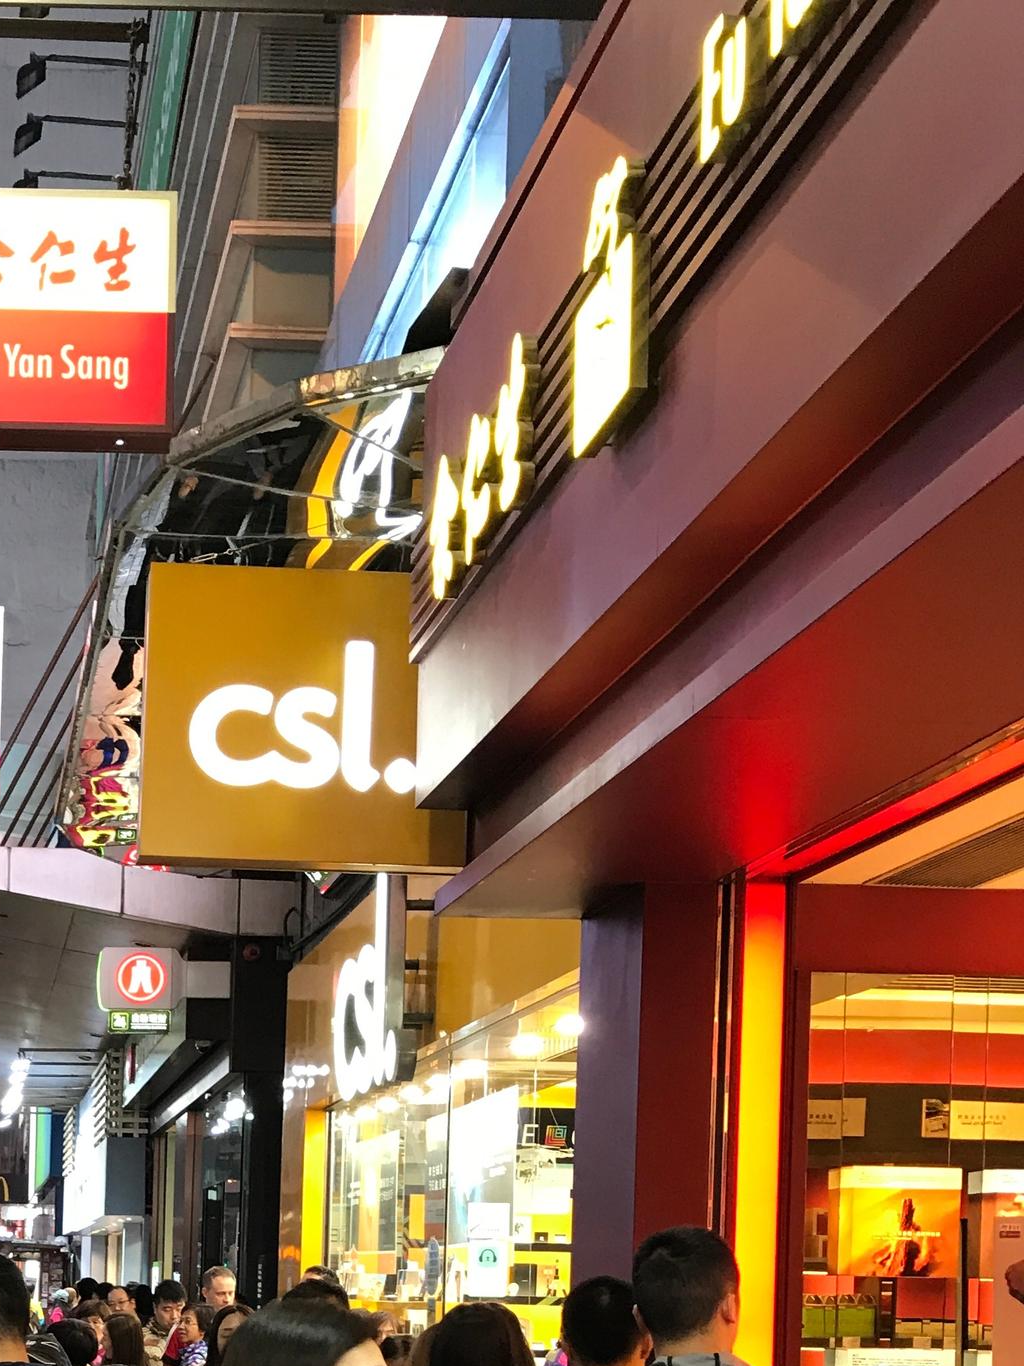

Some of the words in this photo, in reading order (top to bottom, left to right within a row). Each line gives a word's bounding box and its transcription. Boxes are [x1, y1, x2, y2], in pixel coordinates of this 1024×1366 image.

[3, 343, 53, 379] Yan
[60, 344, 129, 390] Sang
[188, 640, 417, 795] csl.
